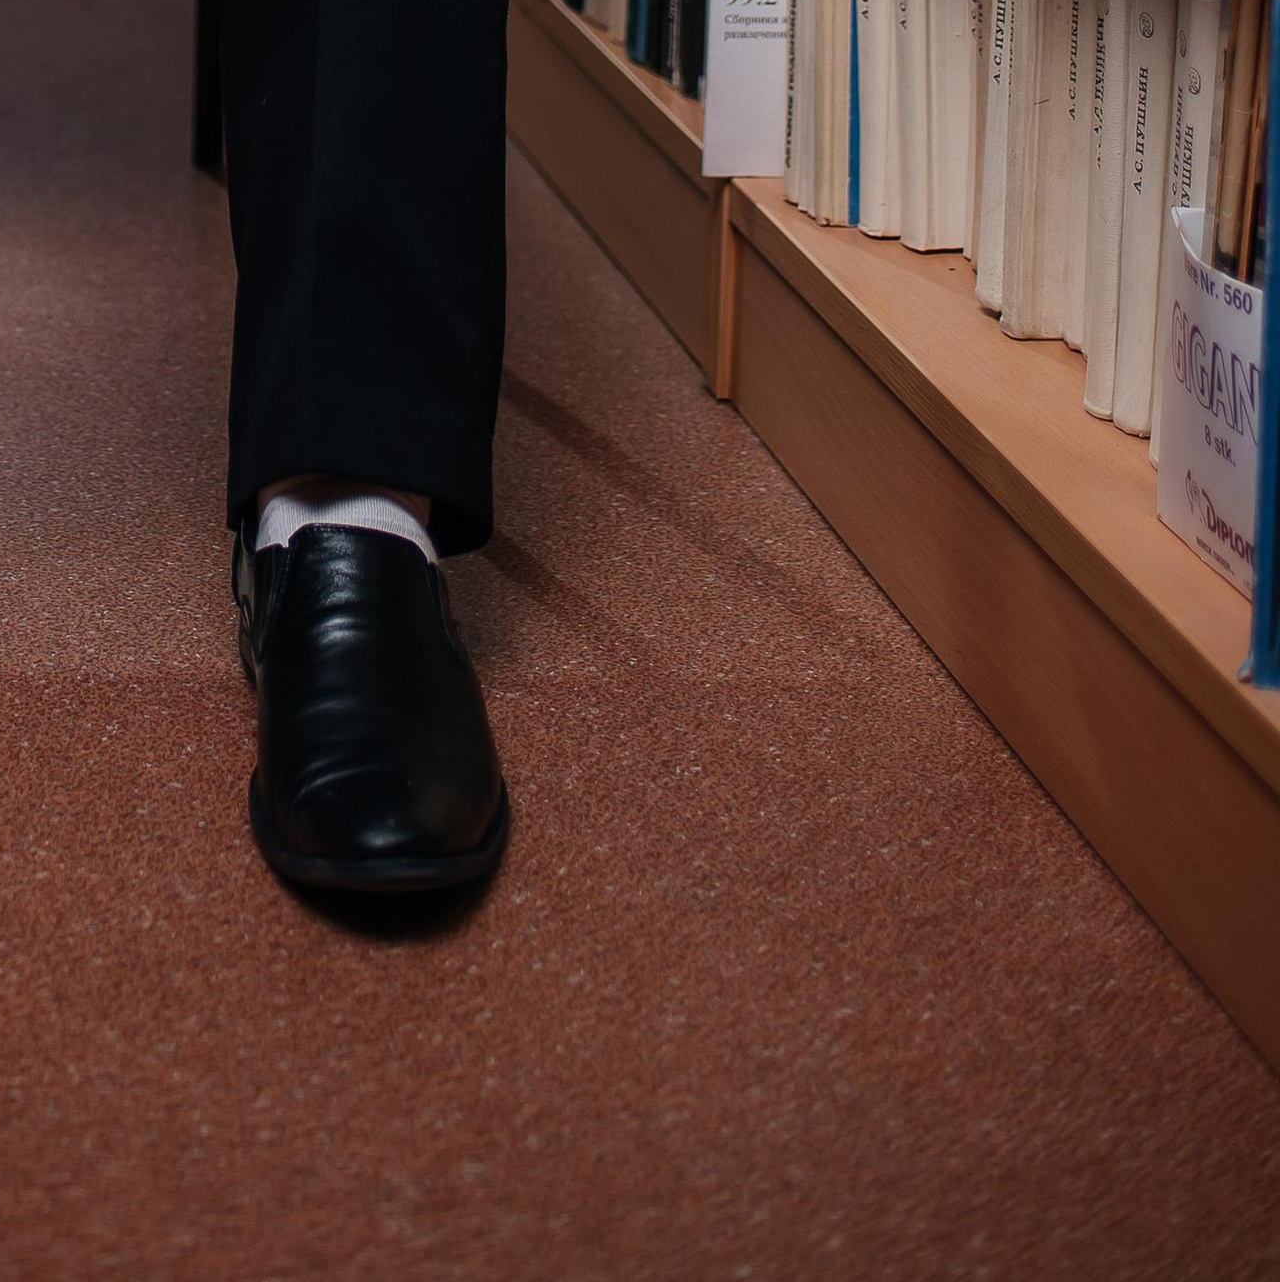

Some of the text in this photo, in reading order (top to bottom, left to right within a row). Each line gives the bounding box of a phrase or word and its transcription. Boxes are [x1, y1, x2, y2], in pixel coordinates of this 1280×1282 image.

[1135, 64, 1150, 156] ПУШКИН
[1199, 271, 1254, 316] Nr. 560
[1204, 424, 1212, 447] 8
